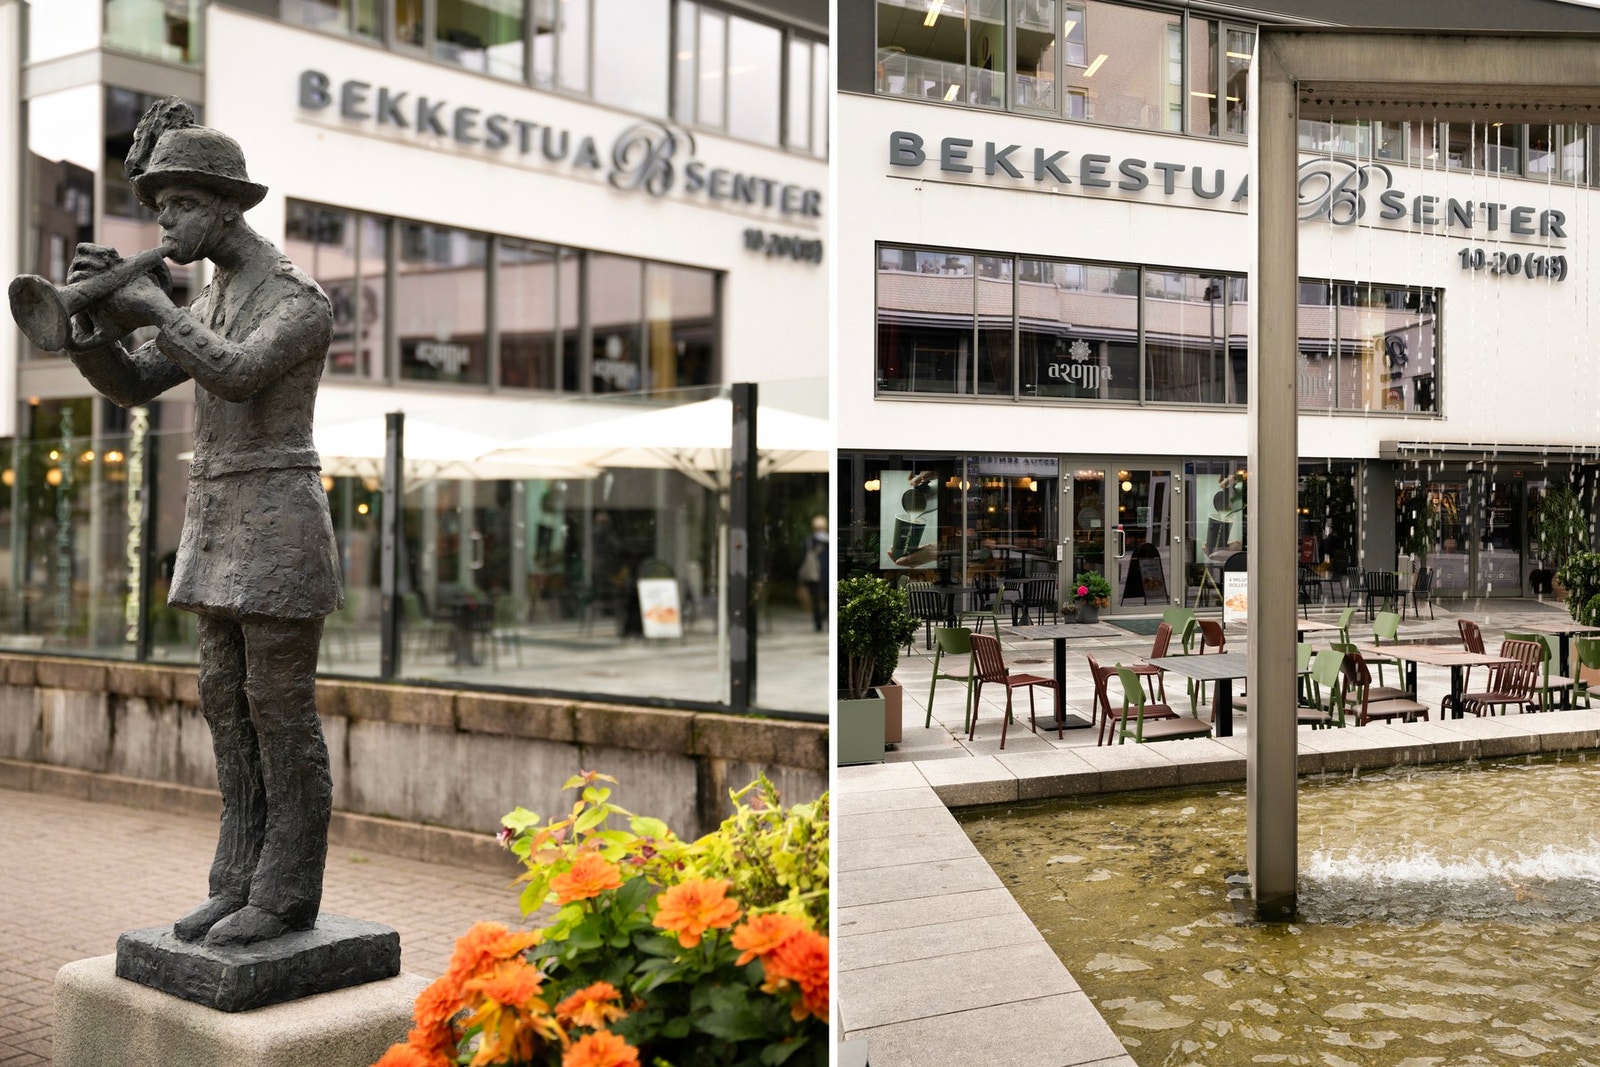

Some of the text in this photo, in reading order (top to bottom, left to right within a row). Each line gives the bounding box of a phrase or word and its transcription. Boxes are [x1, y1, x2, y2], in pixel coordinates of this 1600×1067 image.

[299, 69, 601, 169] BEKKESTUA
[685, 161, 822, 217] SENTER
[1380, 189, 1567, 238] SENTER
[1048, 362, 1113, 389] aroma
